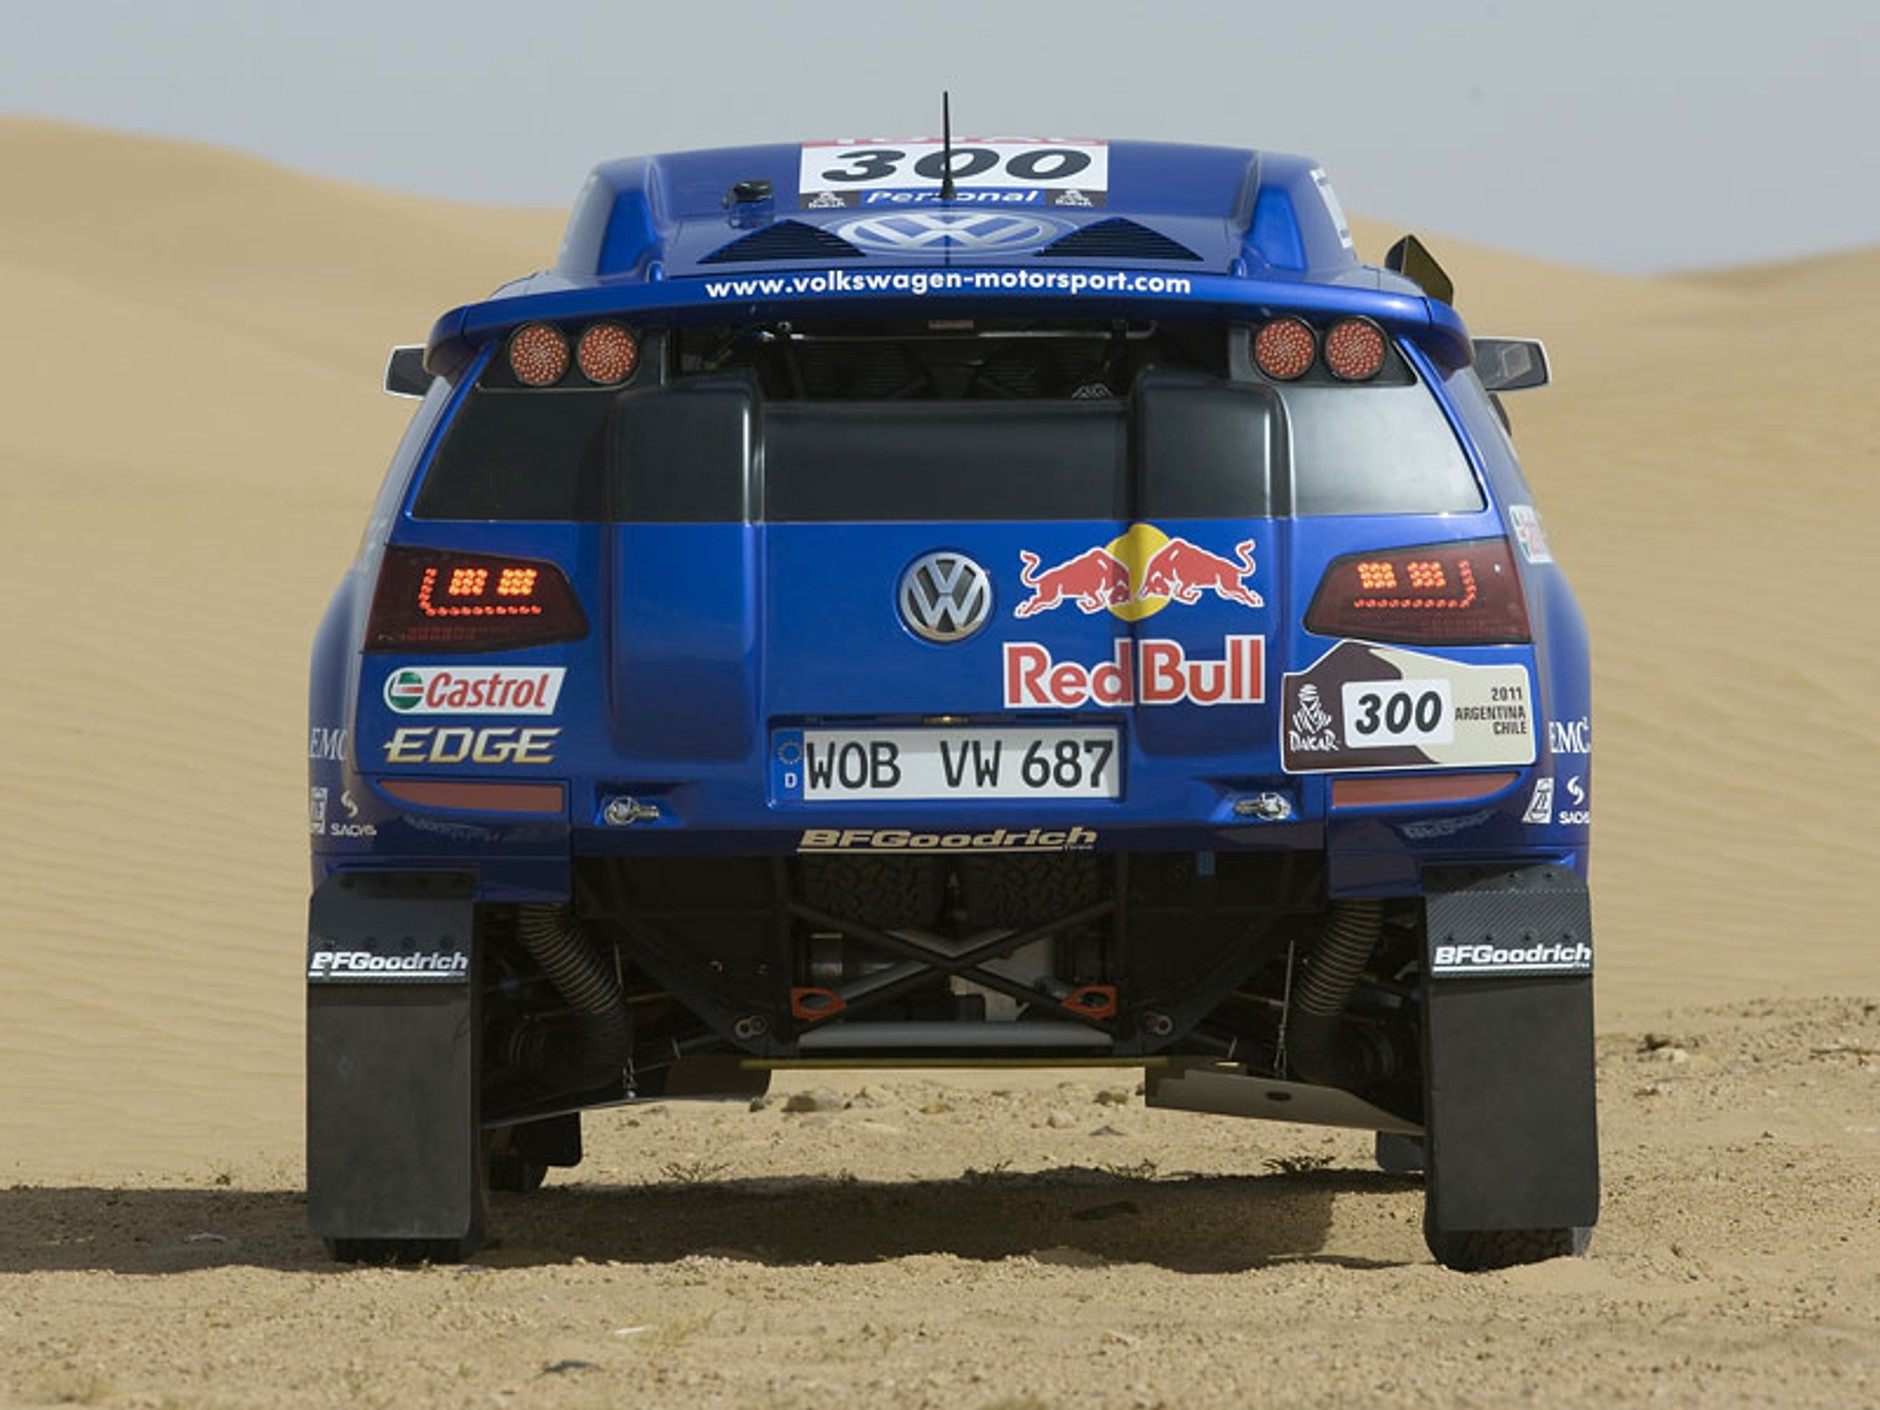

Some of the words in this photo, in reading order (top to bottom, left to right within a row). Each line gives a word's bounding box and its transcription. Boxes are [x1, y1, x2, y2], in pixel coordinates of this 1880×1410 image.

[821, 147, 1092, 182] 300
[705, 270, 1191, 298] www.volkswagen-motorsport.com
[1003, 638, 1134, 708] Red
[1139, 635, 1265, 705] Bull
[427, 672, 550, 709] Castrol
[1491, 686, 1523, 701] 2011
[1356, 691, 1442, 735] 300
[1455, 705, 1526, 721] ARGENTINA
[1493, 721, 1527, 735] CHILE
[383, 727, 562, 764] EDGE
[1289, 730, 1339, 752] DAKAR
[806, 741, 901, 789] WOB
[940, 740, 1003, 788] VW
[1021, 740, 1113, 788] 687
[785, 773, 797, 788] D
[799, 827, 1097, 848] BFGoodrich
[310, 951, 469, 970] BFGoodrich
[1434, 943, 1592, 965] BFGoodrich
